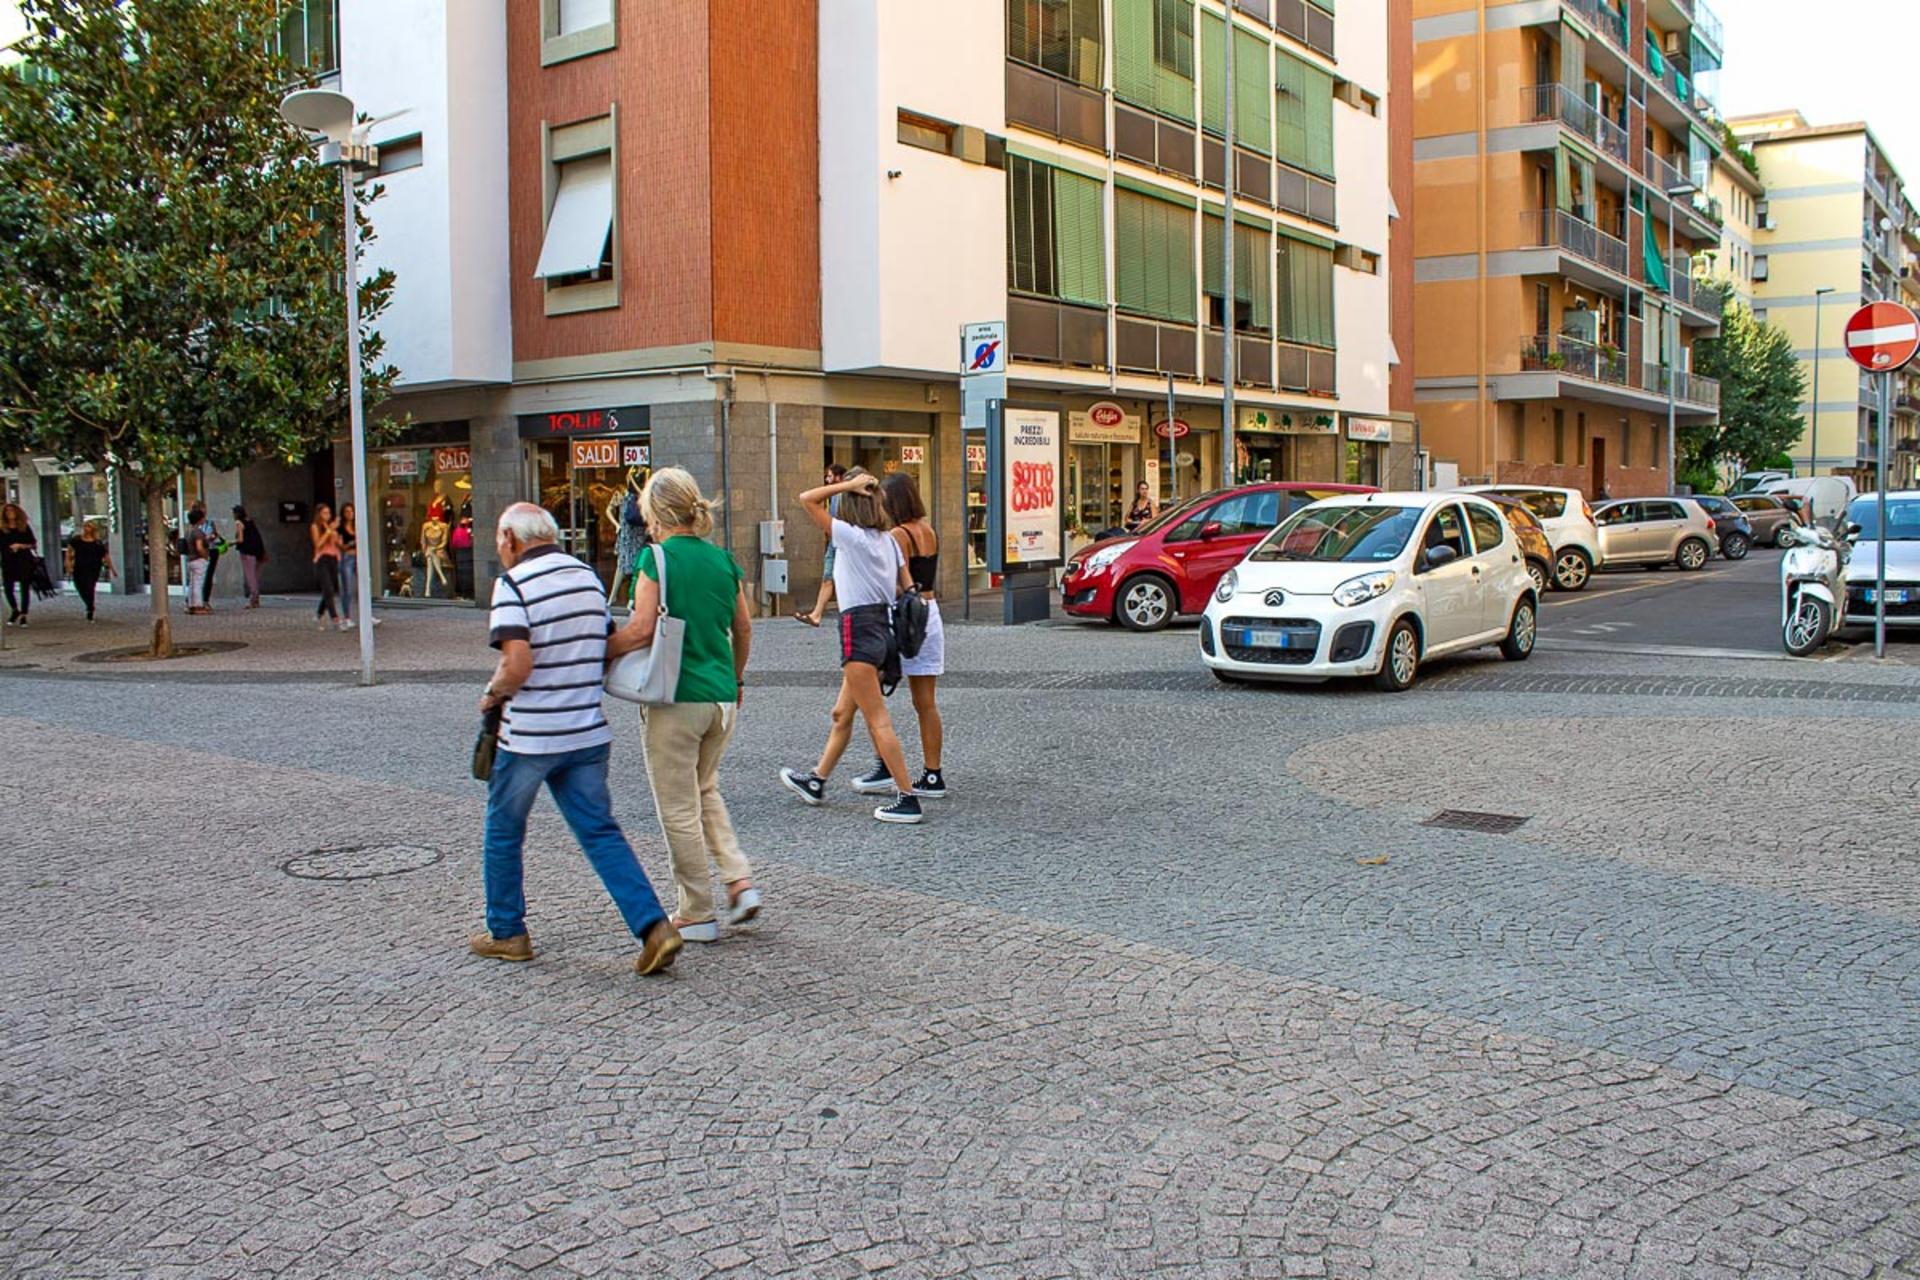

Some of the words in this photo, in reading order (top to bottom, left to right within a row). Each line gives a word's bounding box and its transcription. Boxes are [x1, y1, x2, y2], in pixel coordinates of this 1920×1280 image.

[548, 410, 602, 433] JOLIE
[1020, 424, 1044, 436] PREZZI
[1013, 435, 1051, 446] INCREDIBILI
[439, 451, 470, 471] SALD
[576, 443, 617, 465] SALDI
[626, 448, 637, 462] 50
[903, 448, 913, 461] 50
[967, 447, 977, 459] 50
[1012, 460, 1054, 488] SOTTO
[1011, 486, 1054, 512] COSTO
